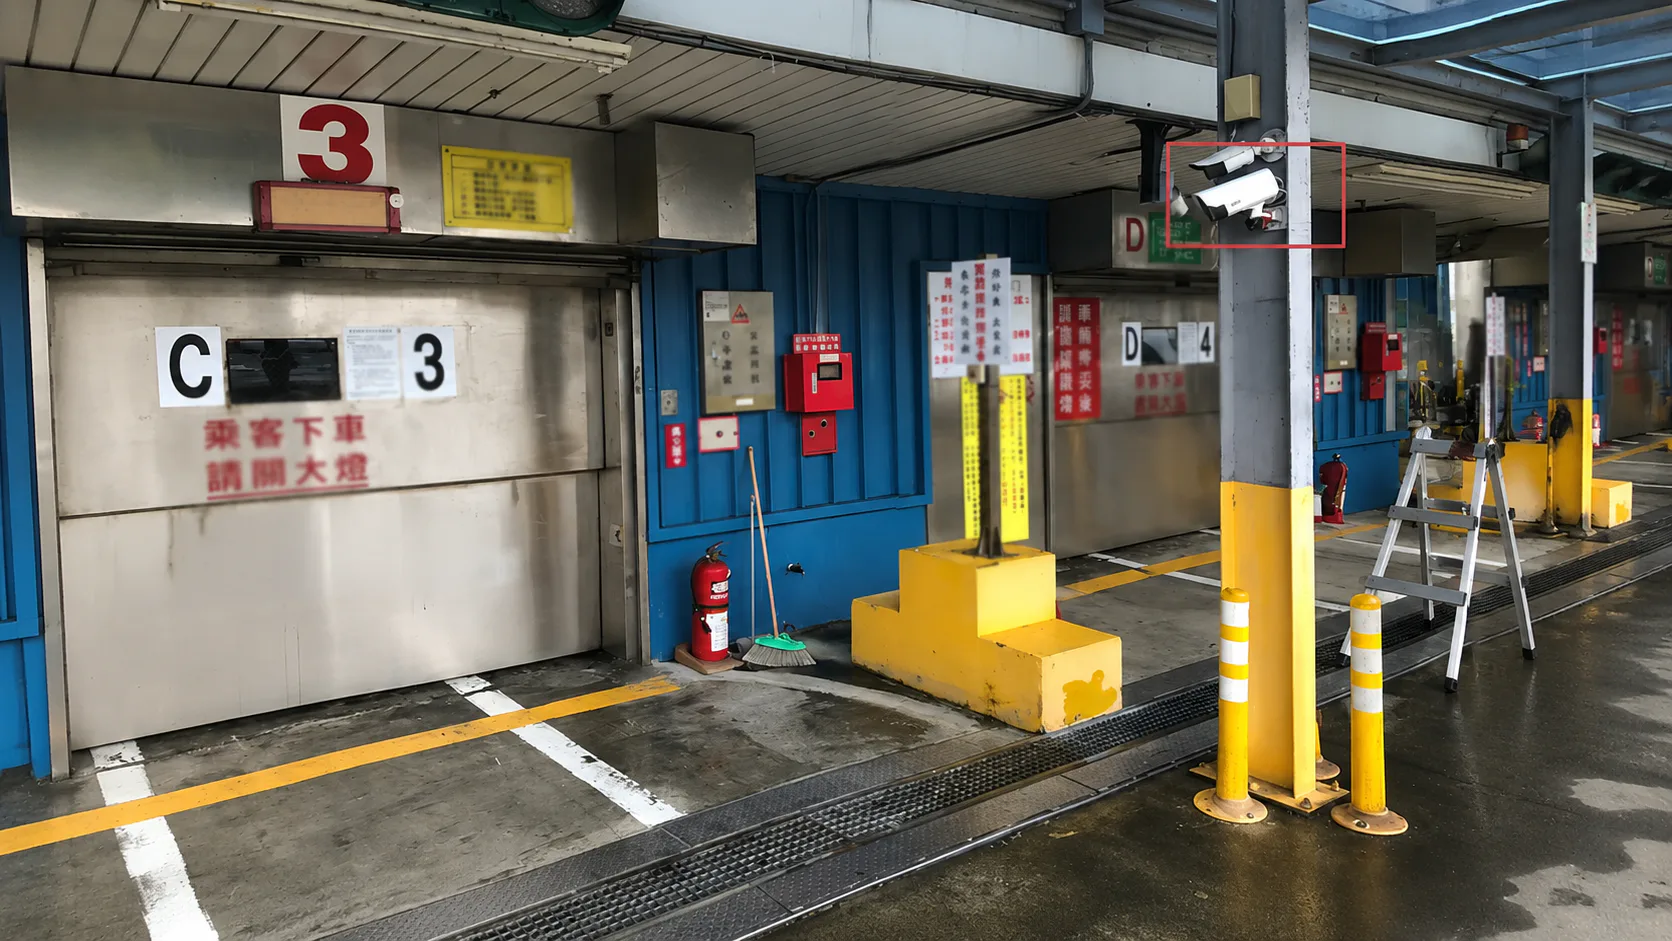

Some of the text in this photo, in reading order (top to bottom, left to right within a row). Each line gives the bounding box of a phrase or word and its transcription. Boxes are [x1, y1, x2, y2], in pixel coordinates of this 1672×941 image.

[298, 104, 374, 184] 3
[1126, 217, 1145, 252] D
[1126, 327, 1138, 361] D
[1200, 326, 1212, 358] 4
[169, 333, 212, 399] C
[414, 333, 445, 391] 3
[203, 414, 366, 450] 乘客下車
